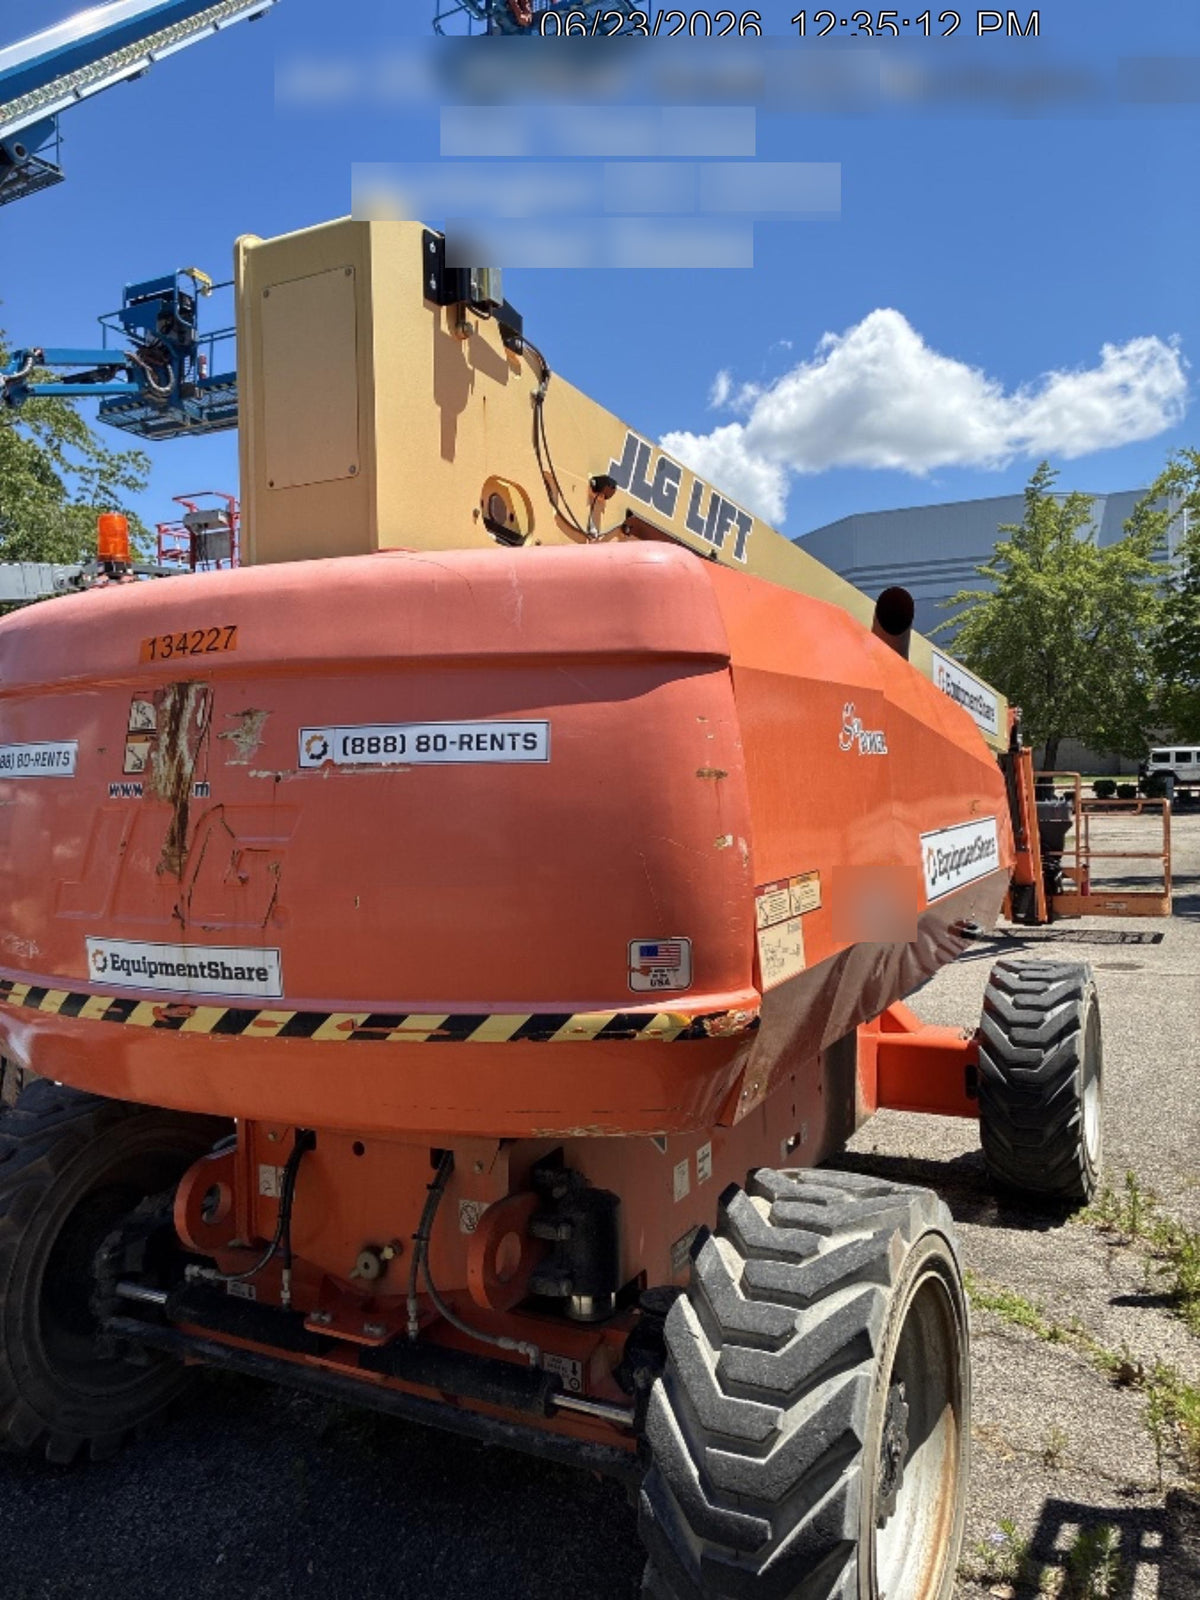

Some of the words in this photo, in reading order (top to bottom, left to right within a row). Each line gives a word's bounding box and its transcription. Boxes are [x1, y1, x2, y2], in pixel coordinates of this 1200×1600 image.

[607, 429, 684, 521] JLG
[684, 476, 755, 565] LIFT
[148, 625, 238, 660] 134227
[342, 733, 407, 757] (888)
[415, 731, 539, 754] 80-RENTS
[109, 952, 270, 982] EquipmentShare
